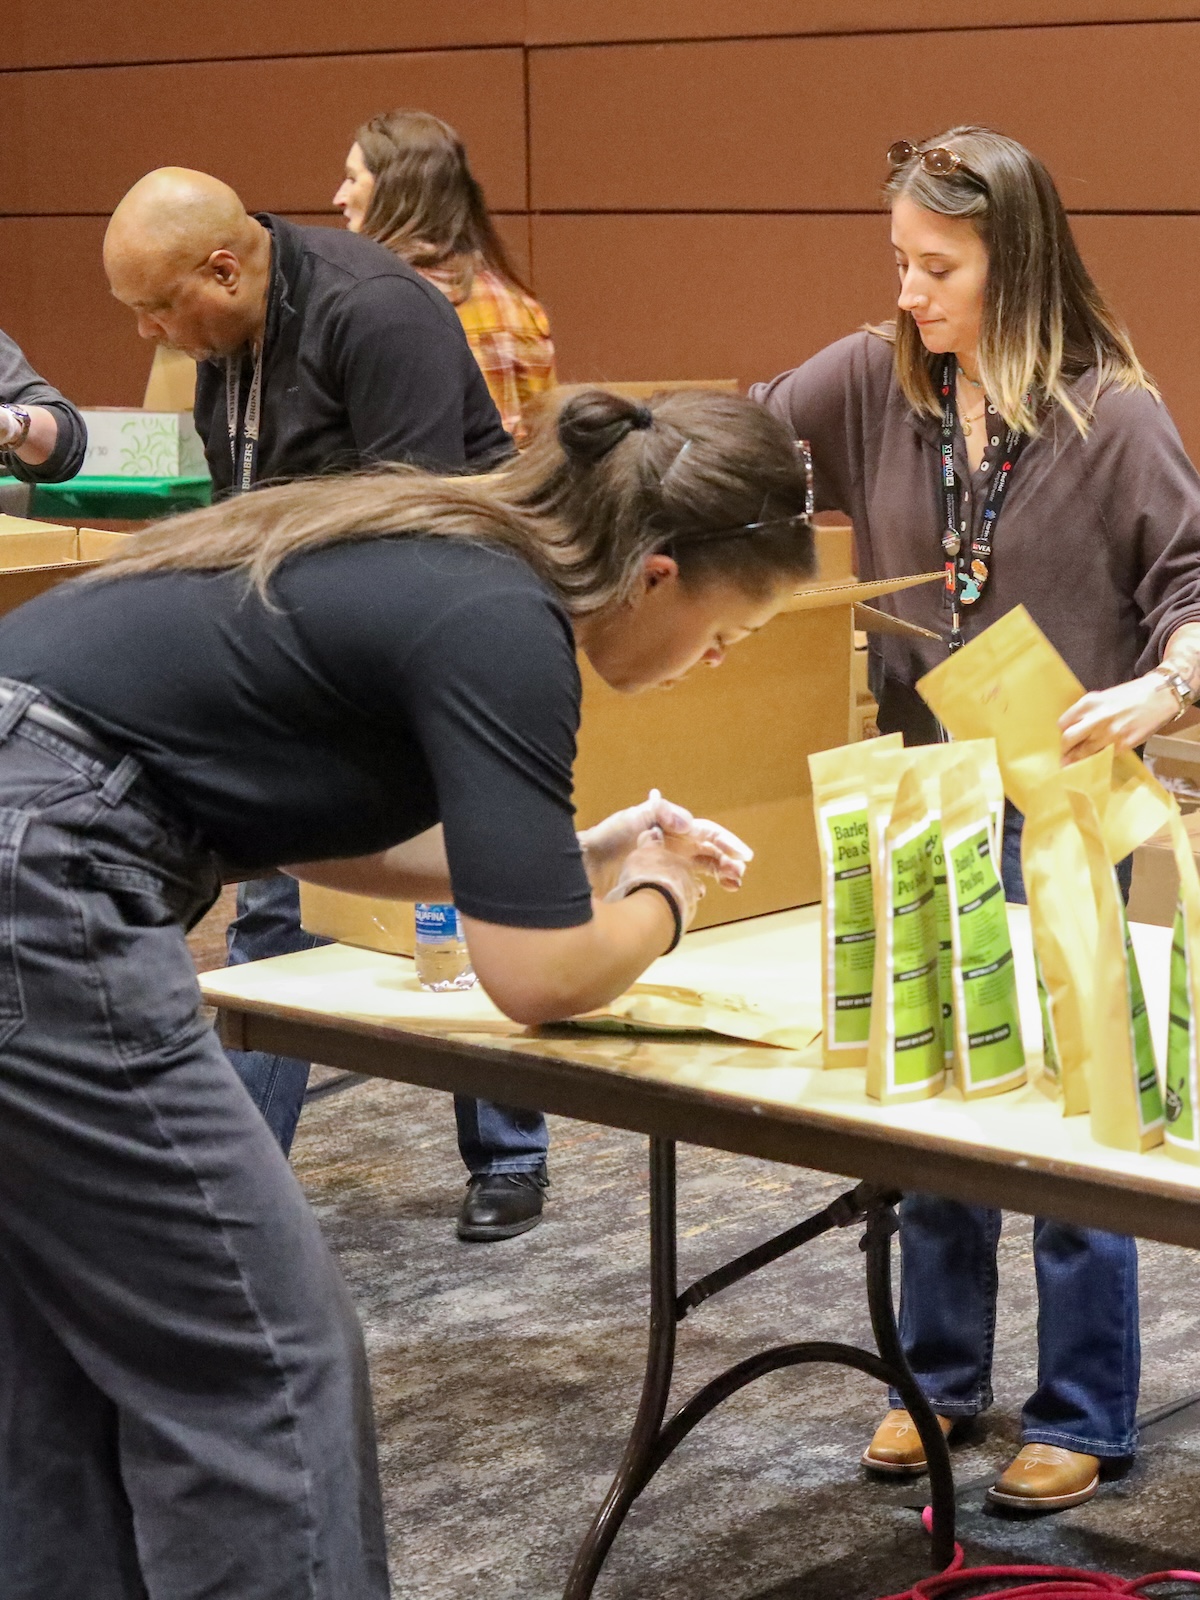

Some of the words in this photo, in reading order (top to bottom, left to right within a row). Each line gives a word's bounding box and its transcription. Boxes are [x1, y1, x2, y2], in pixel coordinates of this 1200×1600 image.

[242, 442, 254, 490] BOMBERS
[248, 388, 258, 422] BRONX
[944, 443, 954, 477] COMPLEX
[838, 845, 860, 861] Pea
